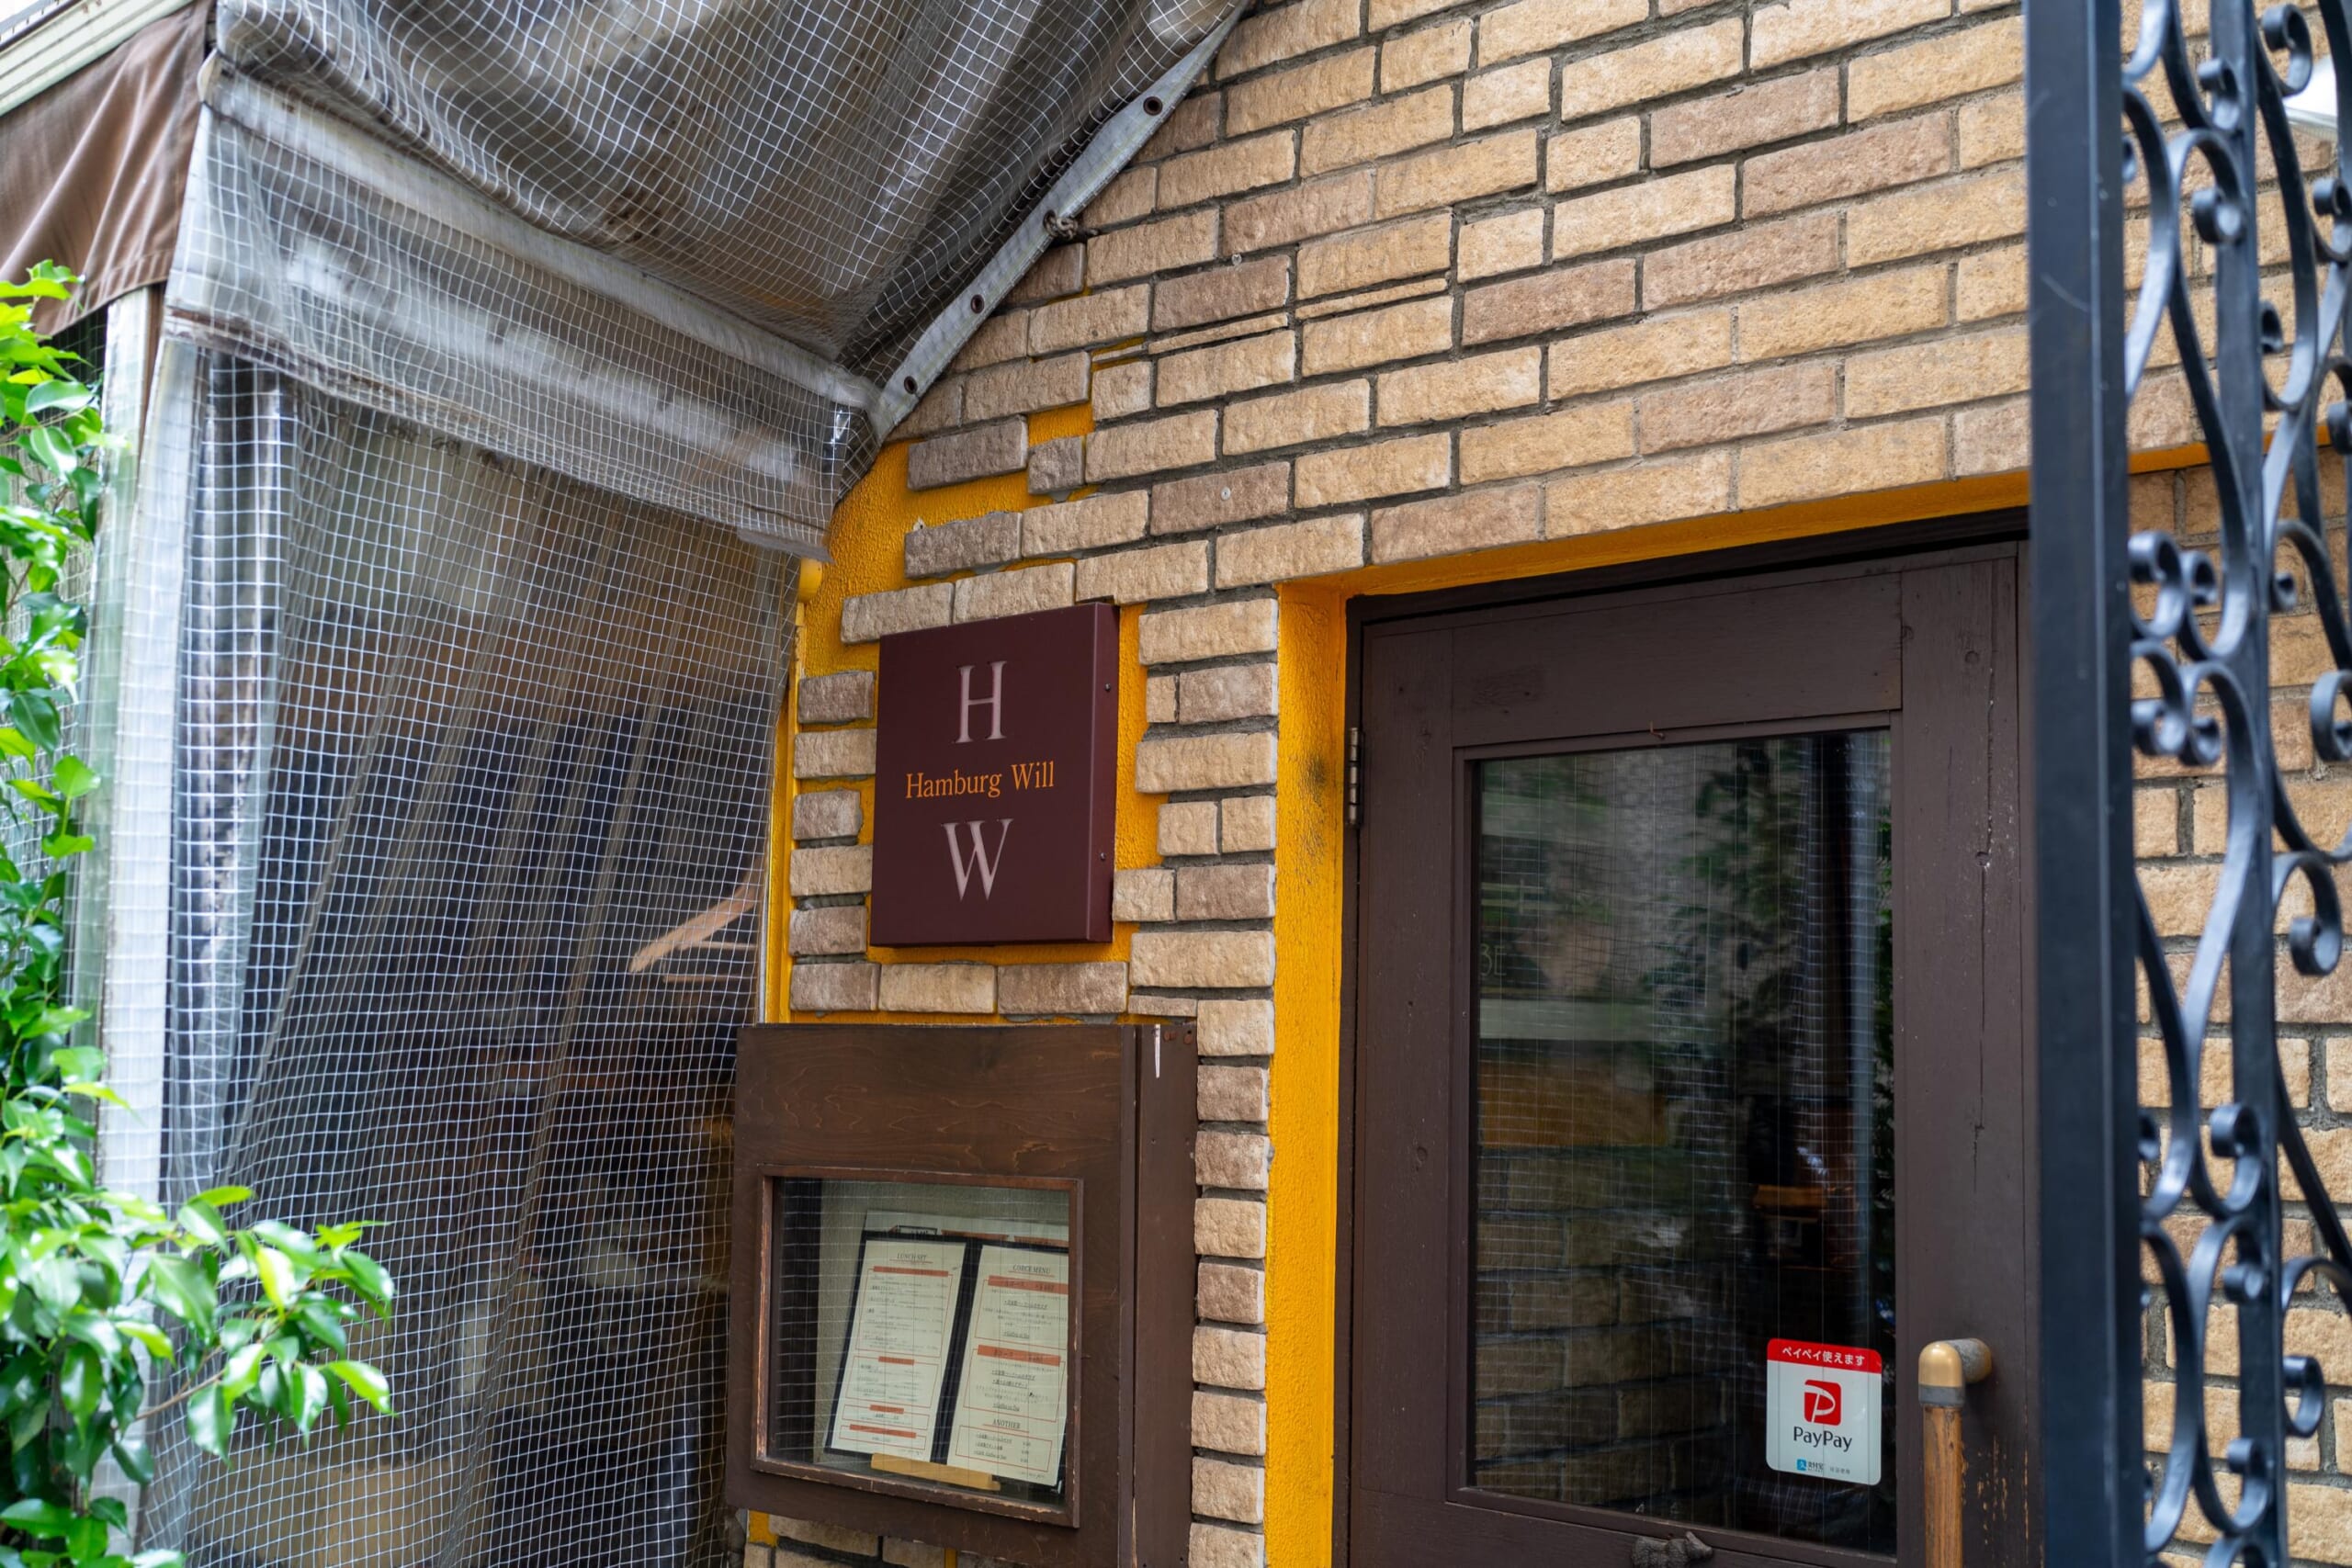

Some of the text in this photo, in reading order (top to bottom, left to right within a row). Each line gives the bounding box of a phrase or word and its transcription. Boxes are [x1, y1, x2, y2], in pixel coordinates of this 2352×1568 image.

[953, 660, 1008, 744] H
[906, 761, 1055, 798] Hamburg Will
[941, 818, 1014, 901] W
[1782, 1347, 1865, 1367] ペイペイ使えます
[992, 1418, 1022, 1429] ANOTHER
[1793, 1426, 1853, 1452] PayPay
